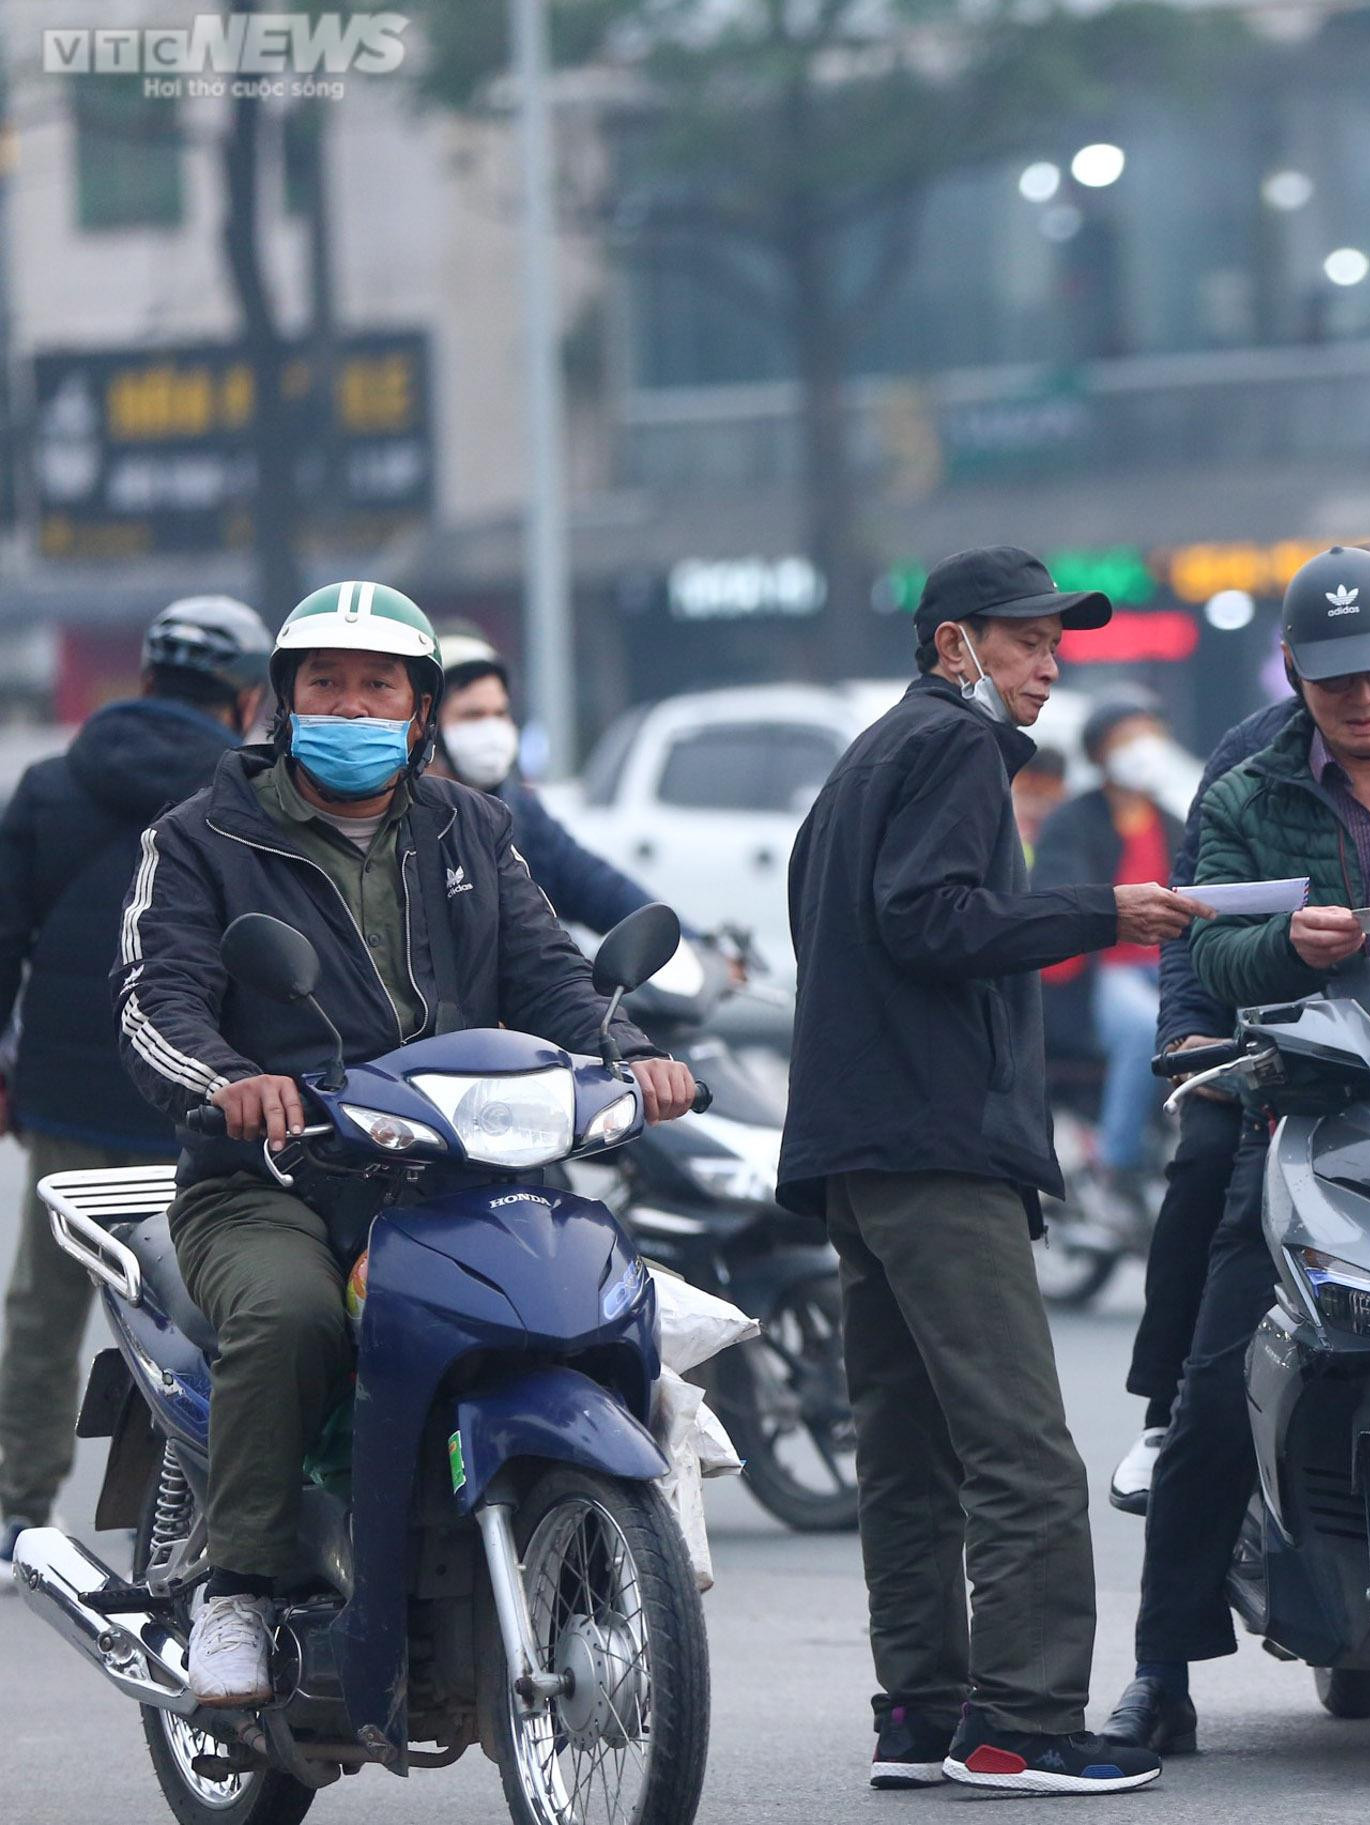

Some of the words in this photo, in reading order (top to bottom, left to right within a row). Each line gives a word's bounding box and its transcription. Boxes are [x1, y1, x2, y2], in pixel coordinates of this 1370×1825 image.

[1328, 606, 1360, 617] adidas
[447, 883, 474, 898] didas
[489, 1193, 552, 1209] HONDA
